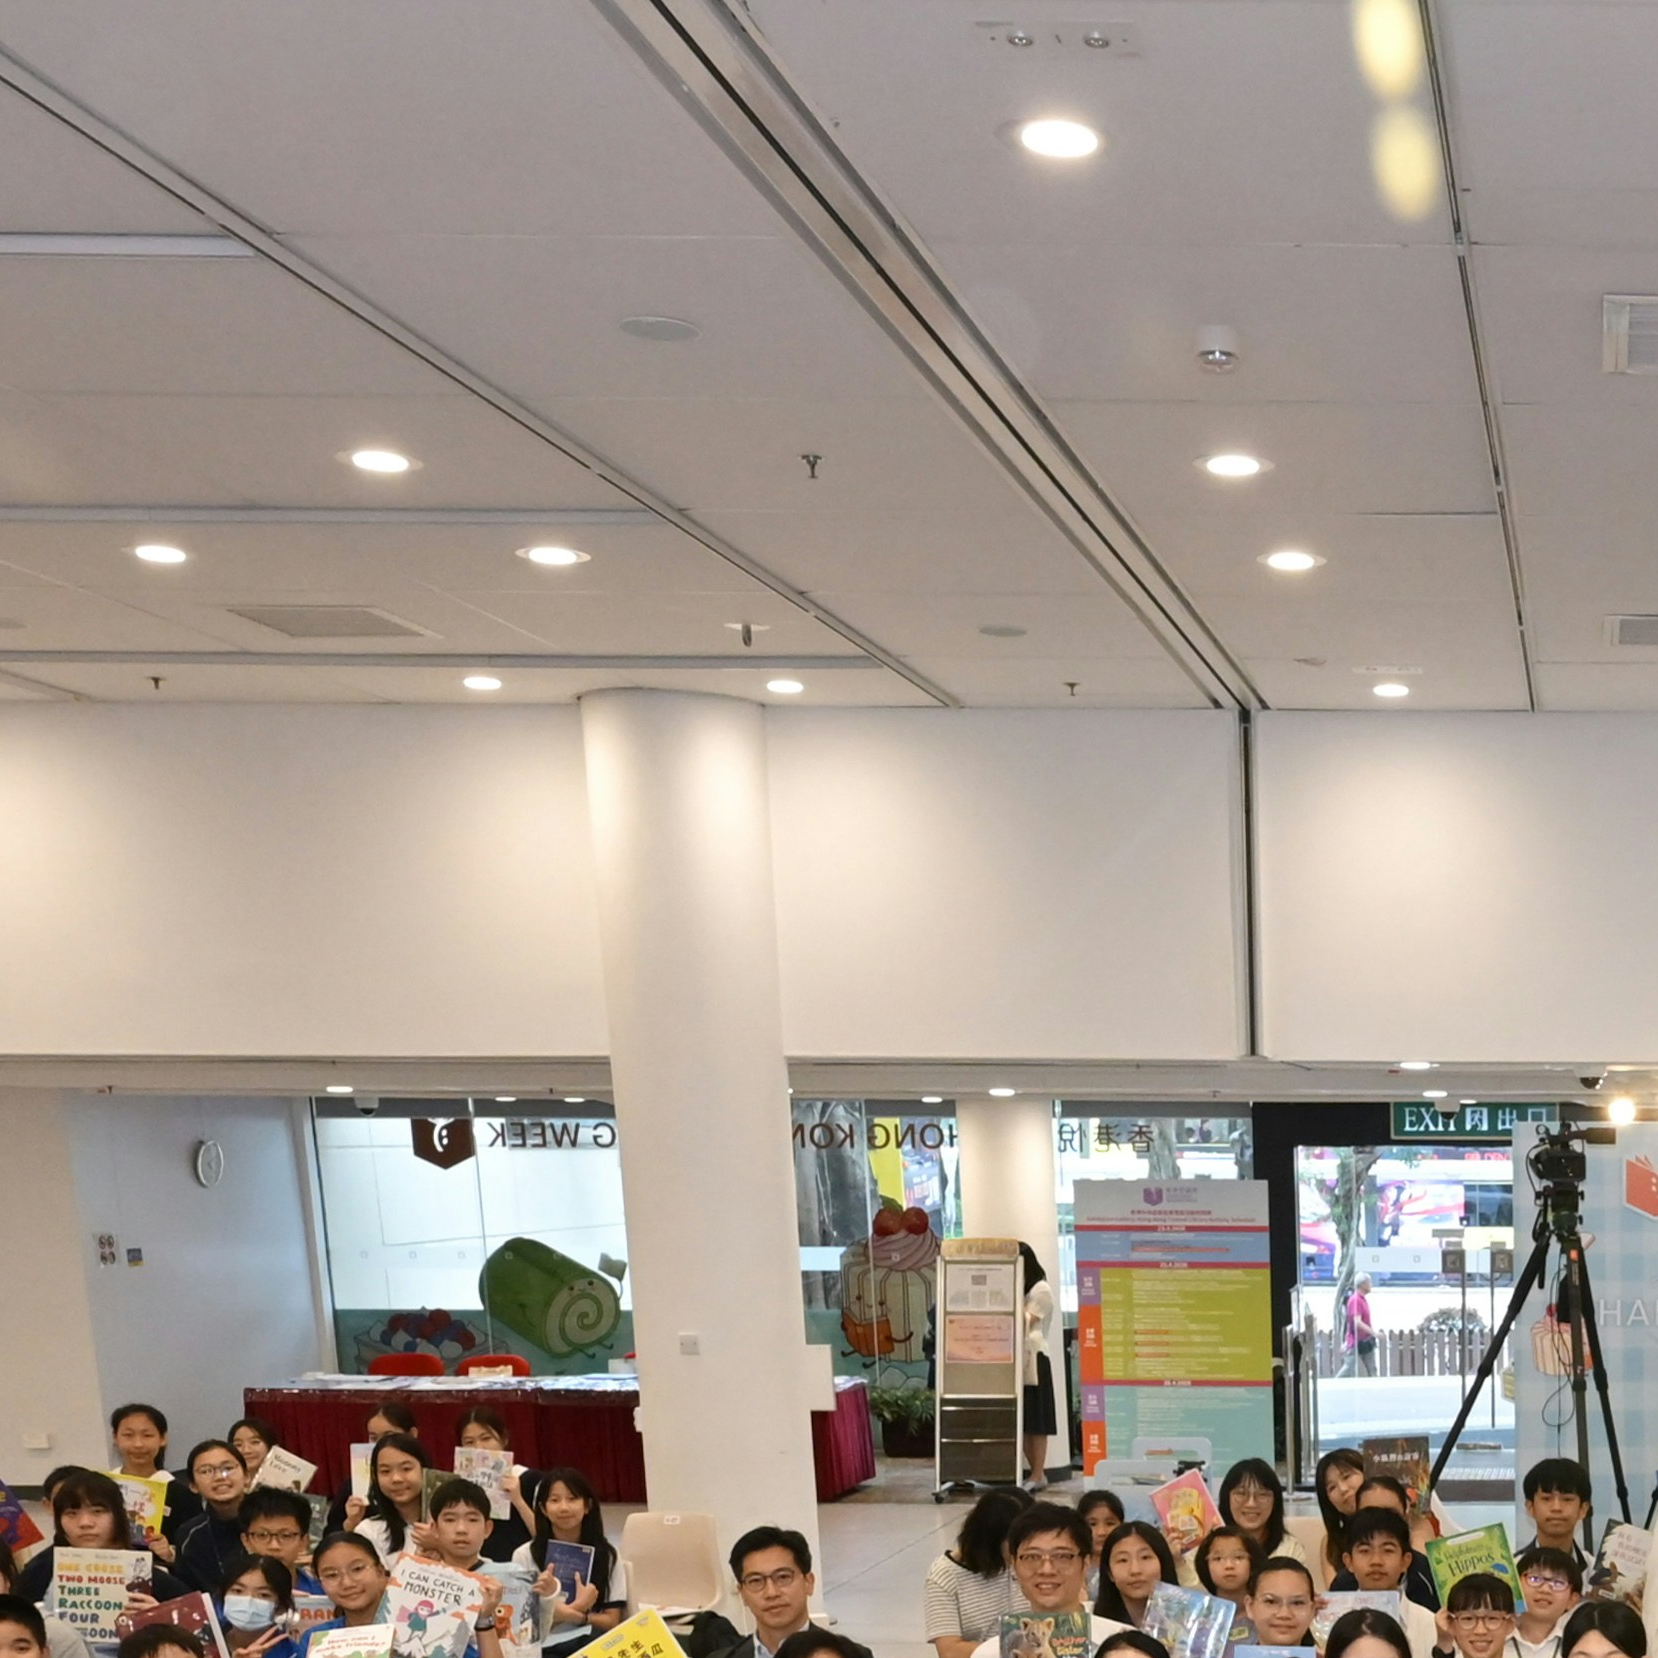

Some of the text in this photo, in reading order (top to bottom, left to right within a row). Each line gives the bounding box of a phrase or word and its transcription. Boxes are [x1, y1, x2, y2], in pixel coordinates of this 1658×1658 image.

[1403, 1107, 1457, 1132] EXIT
[58, 1585, 100, 1597] THREE
[408, 1571, 429, 1585] CAN
[433, 1578, 464, 1595] CATCH
[403, 1580, 462, 1607] MONSTER
[58, 1598, 123, 1611] RACCOON
[58, 1612, 100, 1625] FOUR
